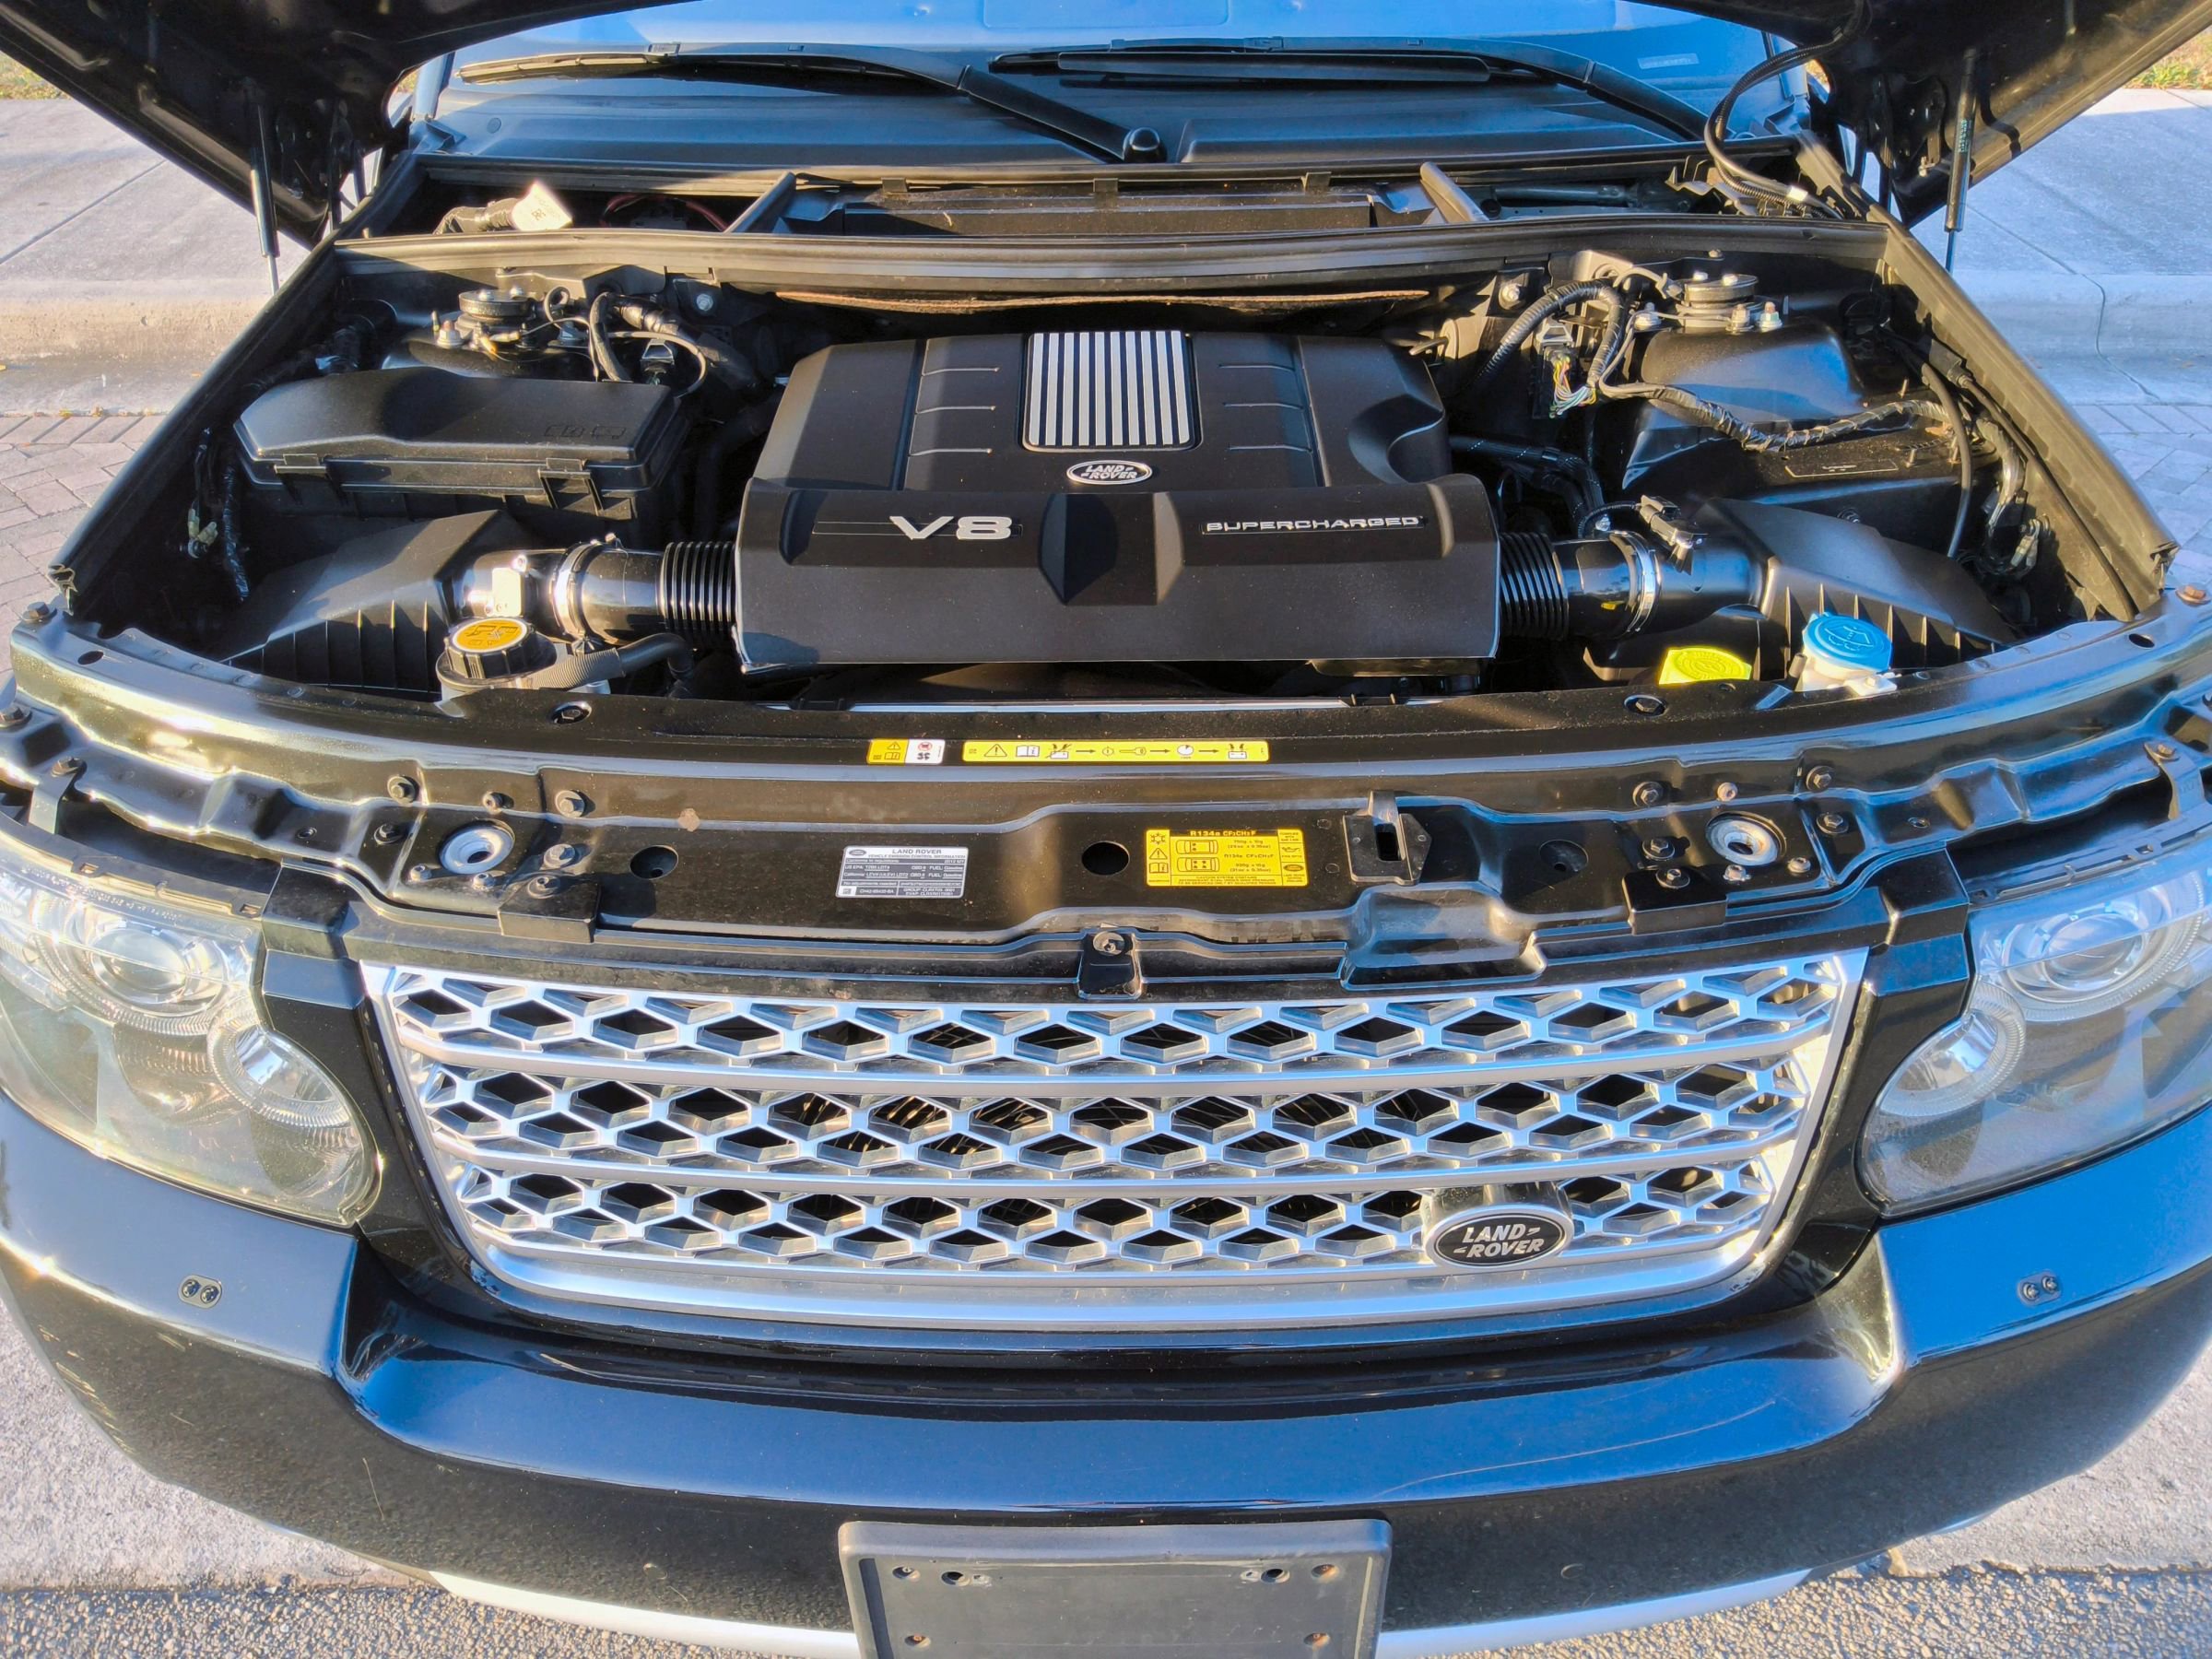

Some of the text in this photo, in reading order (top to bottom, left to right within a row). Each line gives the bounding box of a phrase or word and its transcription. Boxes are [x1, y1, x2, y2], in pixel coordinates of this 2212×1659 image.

[1086, 465, 1125, 473] LAND
[1088, 471, 1137, 479] ROVER
[888, 515, 1013, 540] V8
[1206, 516, 1420, 532] SUPERCHARGED
[1462, 1223, 1527, 1243] LAND
[1466, 1239, 1545, 1258] ROVER
